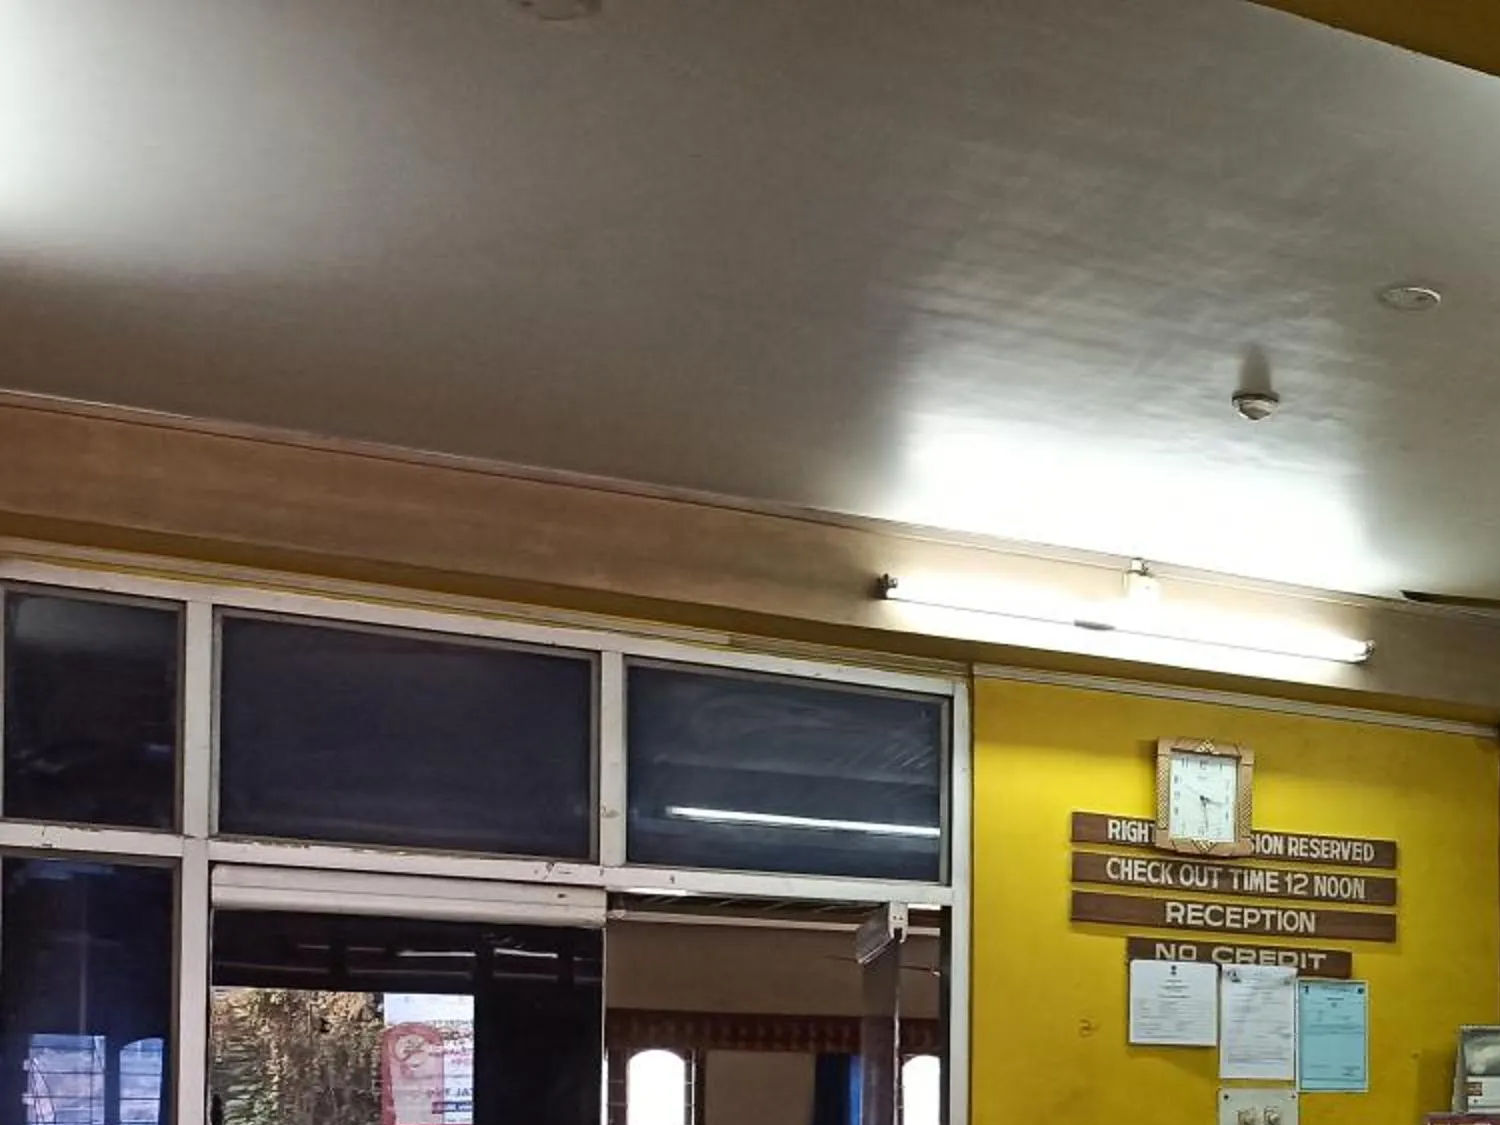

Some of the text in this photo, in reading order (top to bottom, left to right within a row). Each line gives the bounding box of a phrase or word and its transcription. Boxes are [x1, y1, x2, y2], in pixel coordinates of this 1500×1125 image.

[1287, 835, 1375, 863] RESERVED
[1105, 857, 1366, 900] CHECK OUT TIME 12 NOON
[1165, 900, 1317, 934] RECEPTION
[1154, 943, 1328, 971] NO CREDIT
